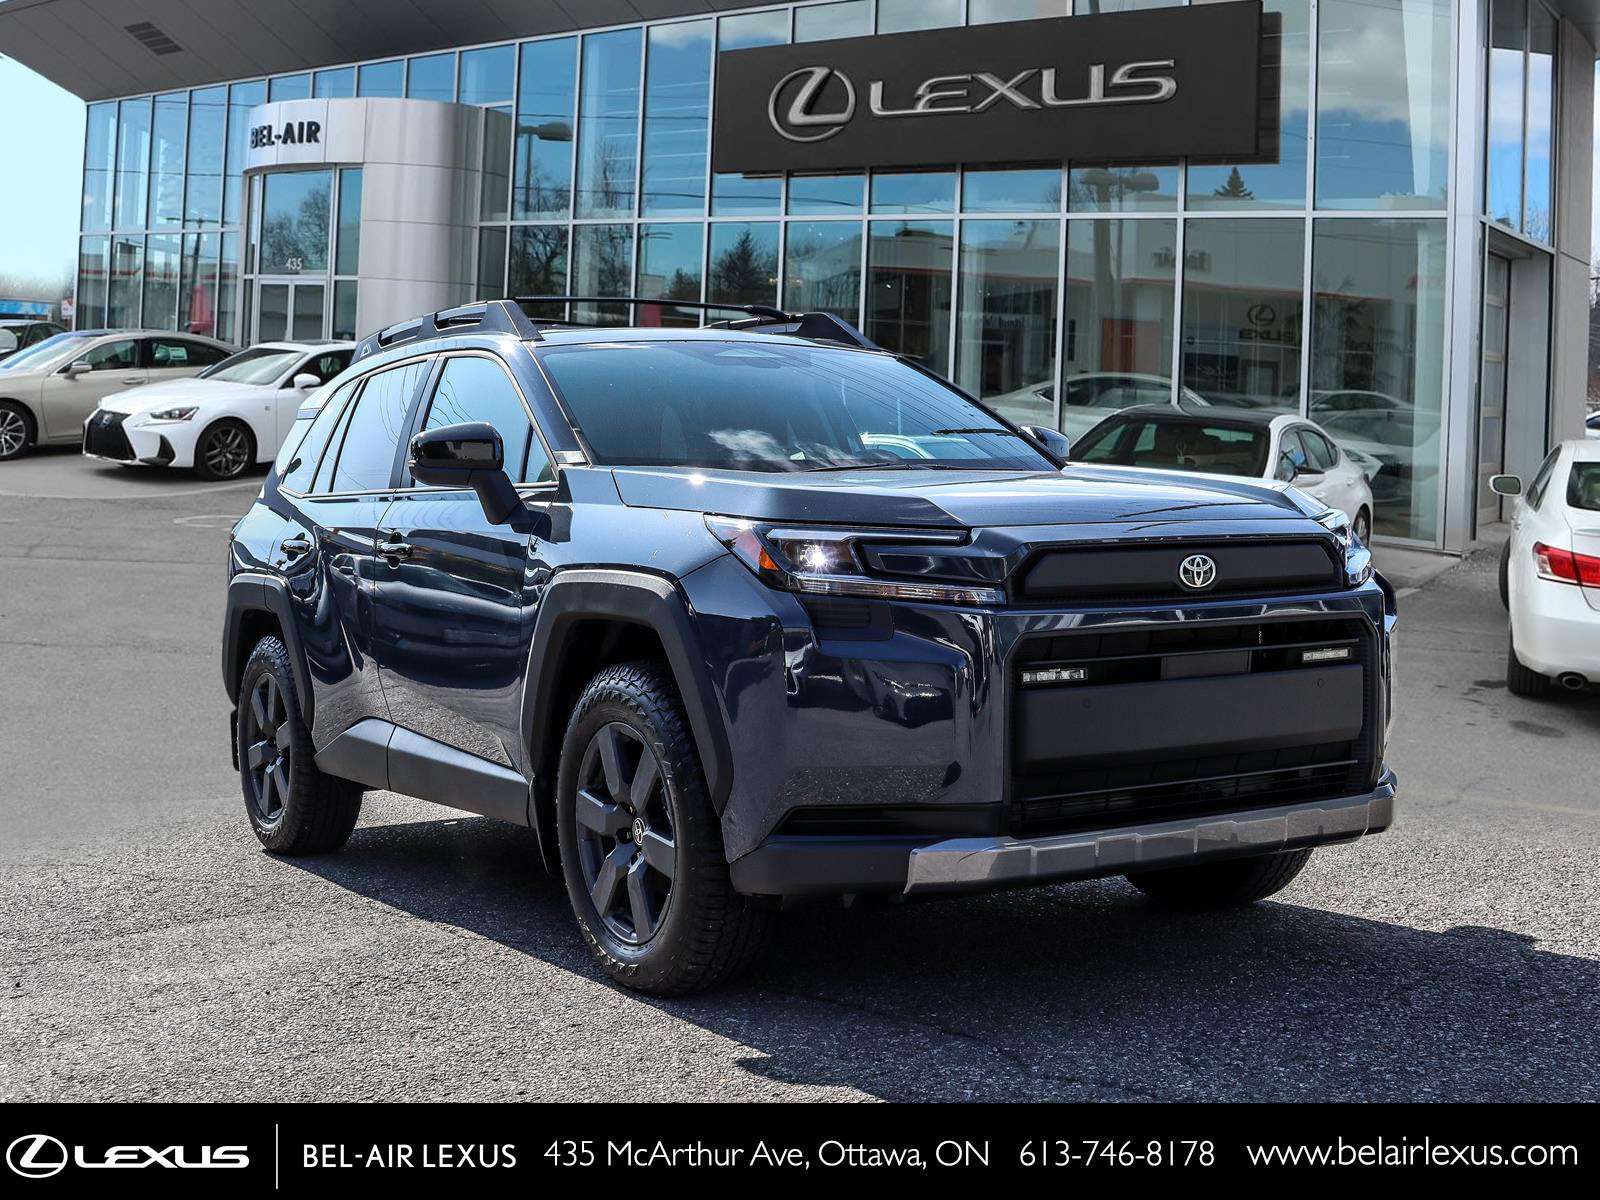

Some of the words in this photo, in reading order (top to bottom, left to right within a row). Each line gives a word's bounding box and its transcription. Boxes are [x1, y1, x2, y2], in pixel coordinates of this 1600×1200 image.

[868, 58, 1178, 117] LEXUS
[250, 120, 321, 149] BEL-AIR
[286, 257, 303, 270] 435
